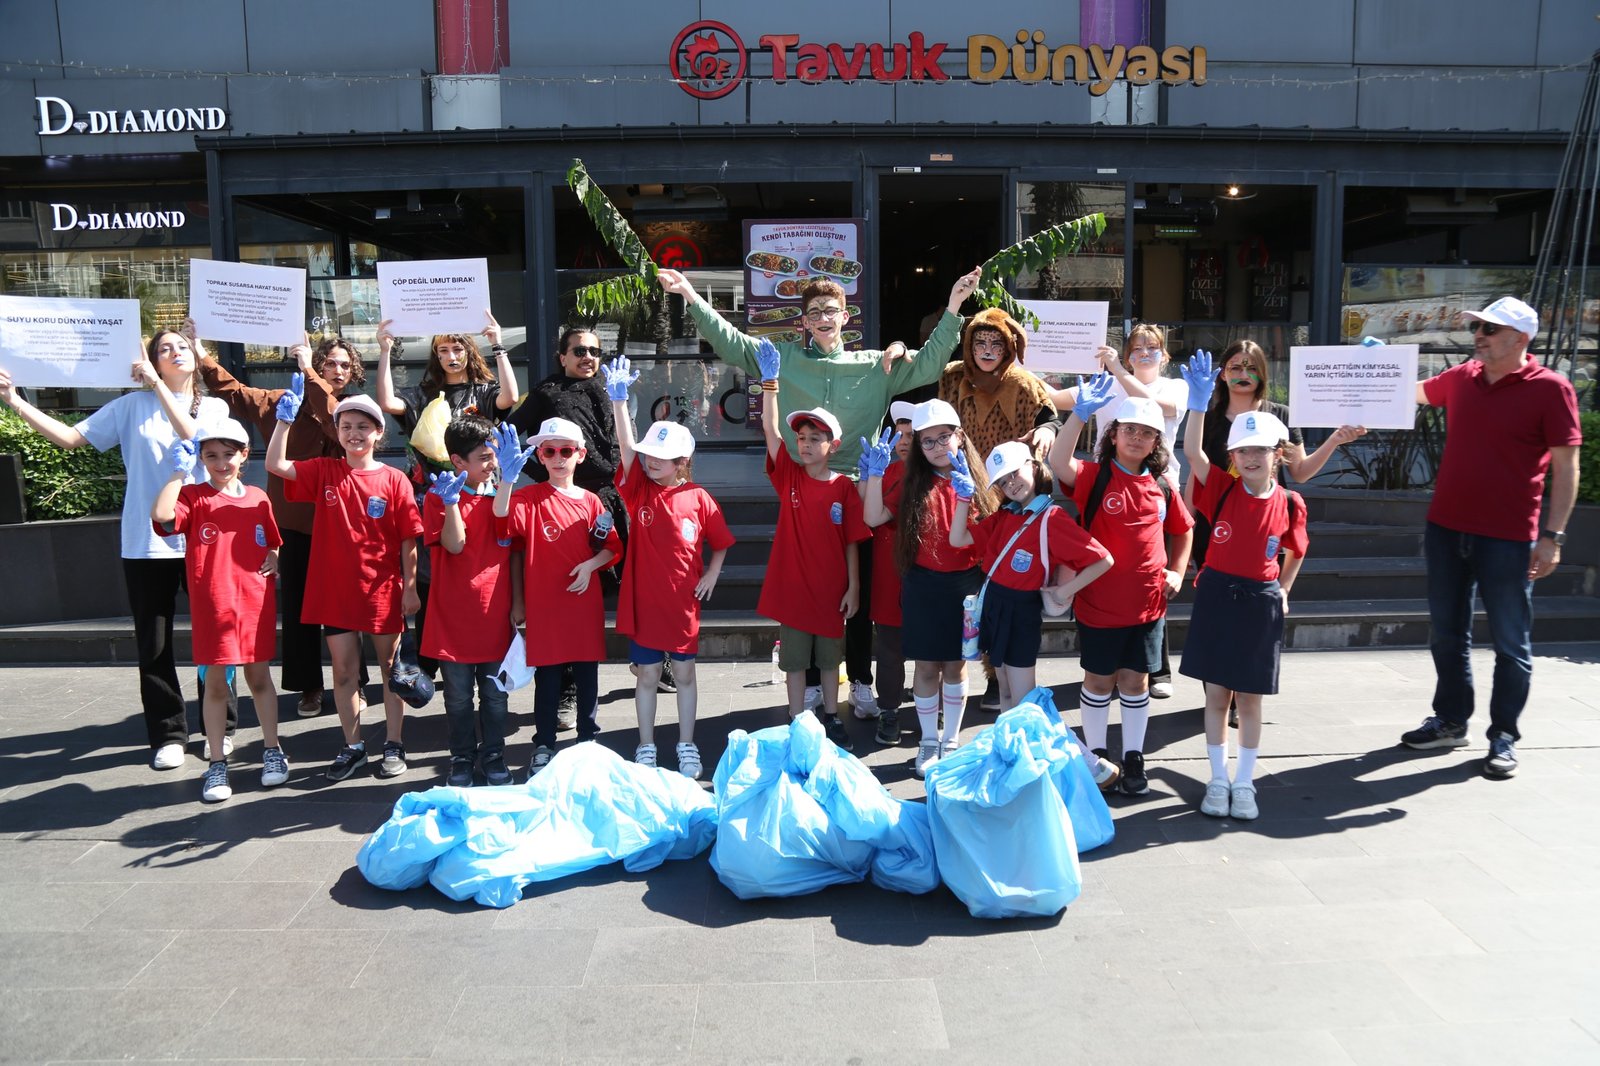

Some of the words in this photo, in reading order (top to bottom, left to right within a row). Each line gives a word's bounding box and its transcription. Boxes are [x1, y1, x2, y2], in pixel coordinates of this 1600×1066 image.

[759, 31, 949, 84] Tavuk
[967, 29, 1207, 96] Dünyası
[35, 96, 73, 135] D
[88, 107, 226, 134] DIAMOND
[51, 203, 78, 231] D
[88, 211, 185, 230] DIAMOND
[761, 232, 782, 242] KENDİ
[783, 230, 814, 238] TABAĞINI
[814, 231, 847, 241] OLUŞTUR!
[206, 279, 228, 287] TOPRAK
[392, 277, 407, 286] ÇÖP
[408, 276, 428, 285] DEĞİL
[58, 316, 96, 325] DÜNYANI
[97, 318, 124, 326] YAŞAT
[1305, 363, 1331, 371] BUGÜN
[1332, 362, 1361, 370] ATTIĞIN
[1362, 362, 1401, 370] KİMYASAL
[1327, 371, 1353, 380] İÇTİĞİN
